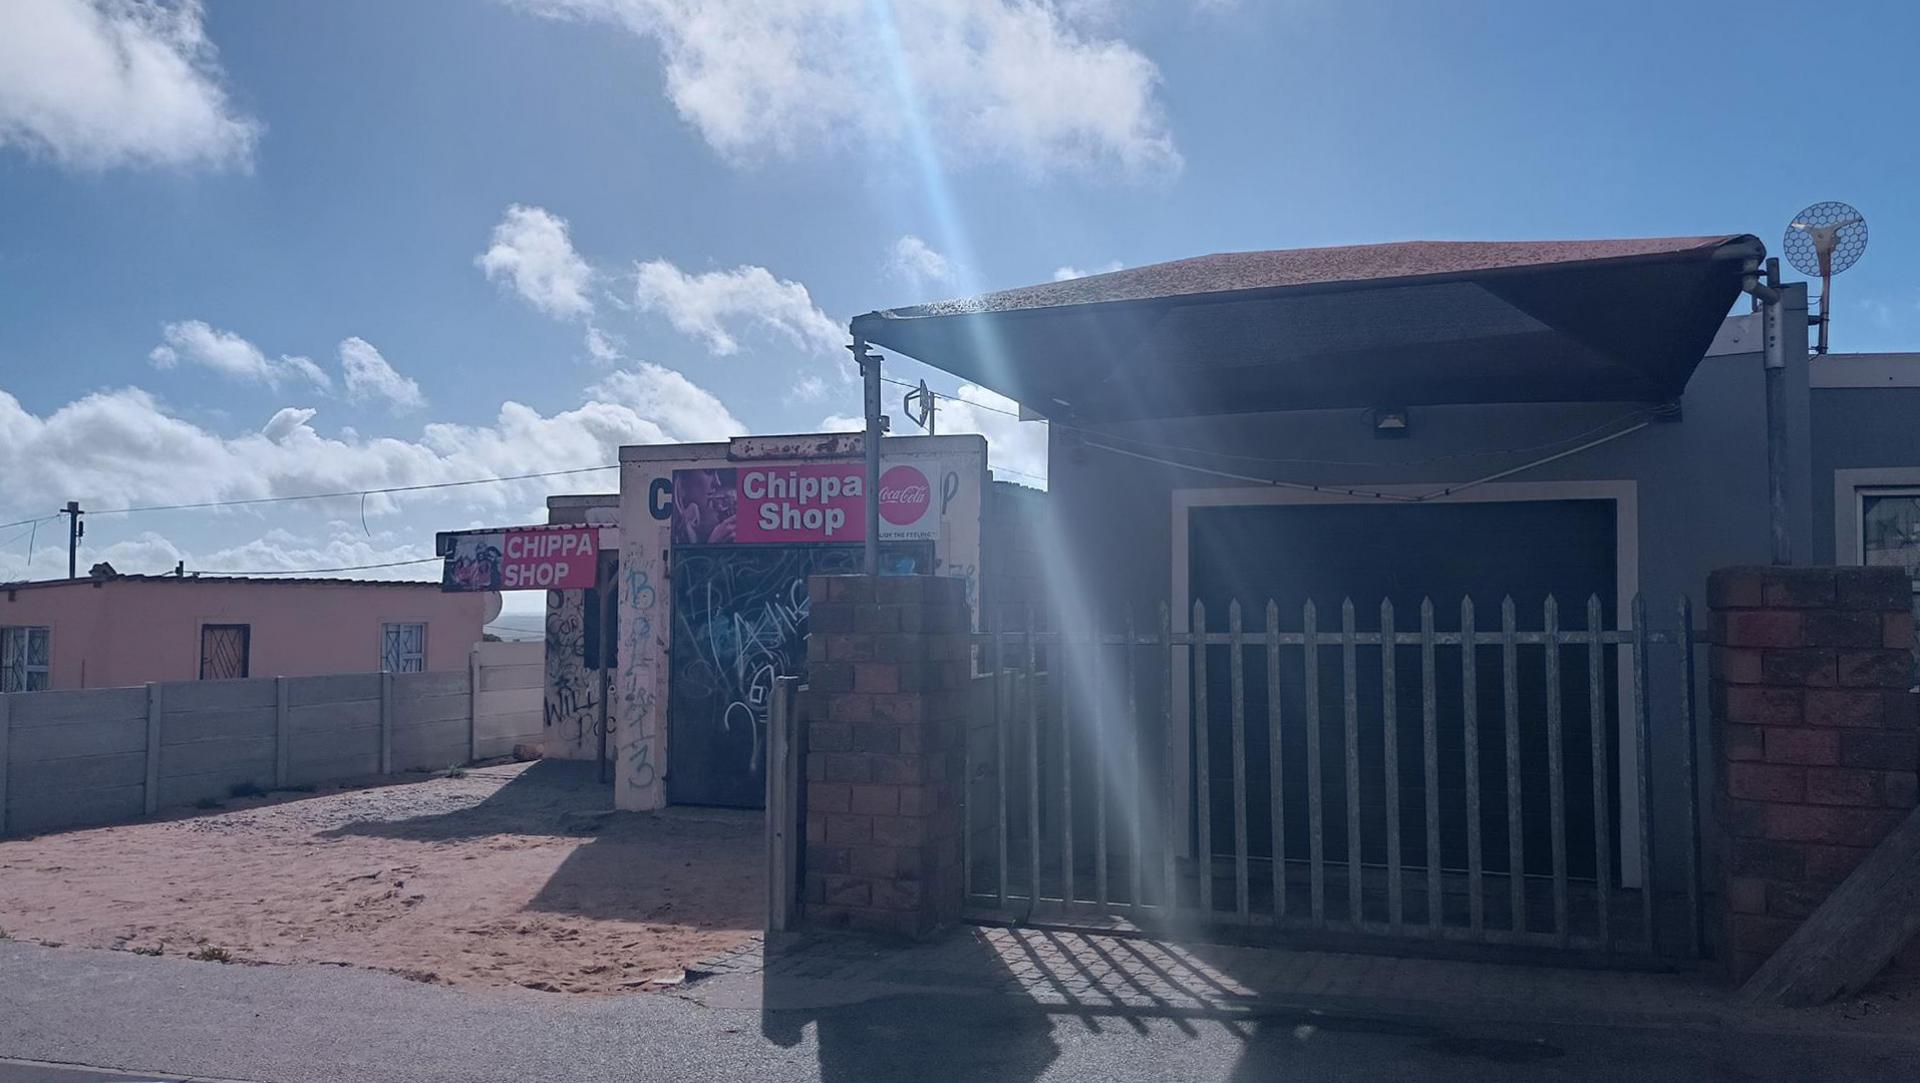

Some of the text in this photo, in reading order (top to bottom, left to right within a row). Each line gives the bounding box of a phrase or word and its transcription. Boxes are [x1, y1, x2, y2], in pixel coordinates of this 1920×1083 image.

[743, 471, 863, 505] Chippa
[759, 502, 845, 536] Shop
[507, 533, 593, 559] CHIPPA
[504, 562, 569, 587] SHOP
